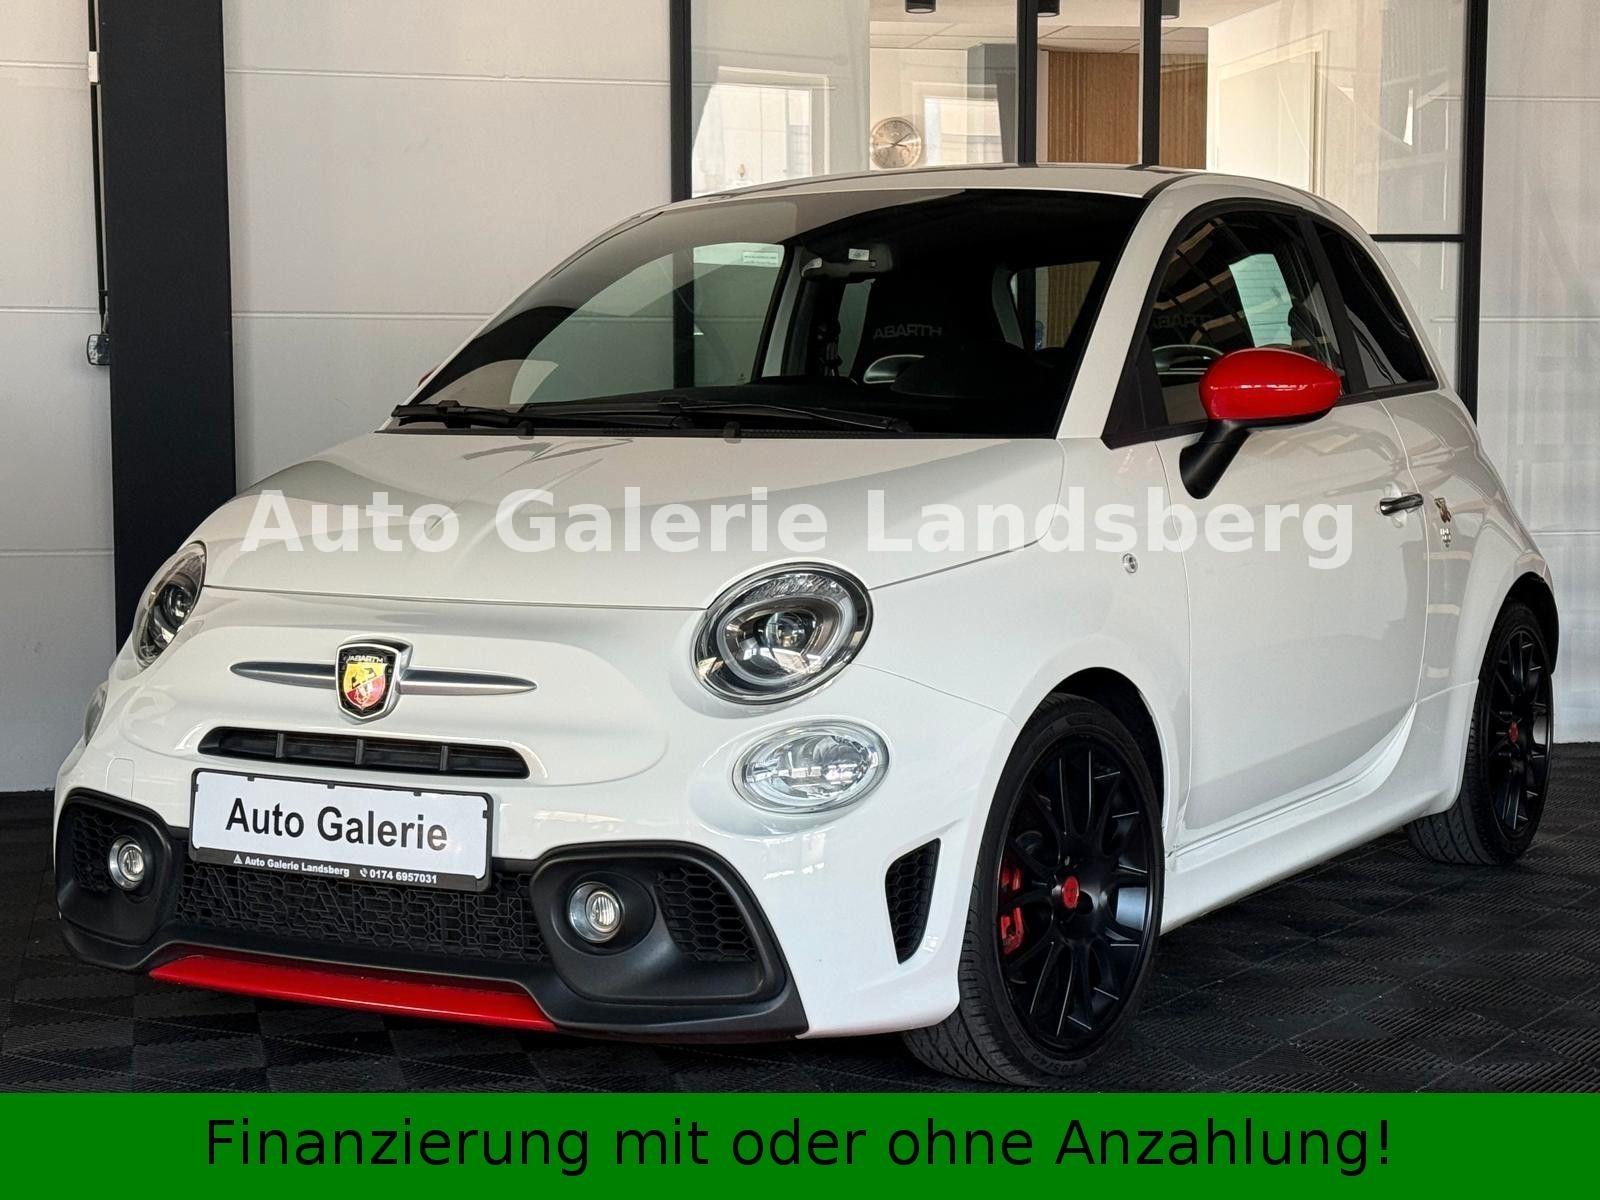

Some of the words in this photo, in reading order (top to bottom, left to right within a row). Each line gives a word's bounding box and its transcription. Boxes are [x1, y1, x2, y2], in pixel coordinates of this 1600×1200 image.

[872, 323, 944, 340] ABARTH
[225, 797, 305, 838] Auto
[317, 806, 448, 851] Galerie
[245, 856, 265, 867] Auto
[267, 858, 300, 871] Galerie
[301, 862, 350, 878] Landsberg
[369, 868, 394, 880] 0174
[395, 871, 437, 884] 6957031
